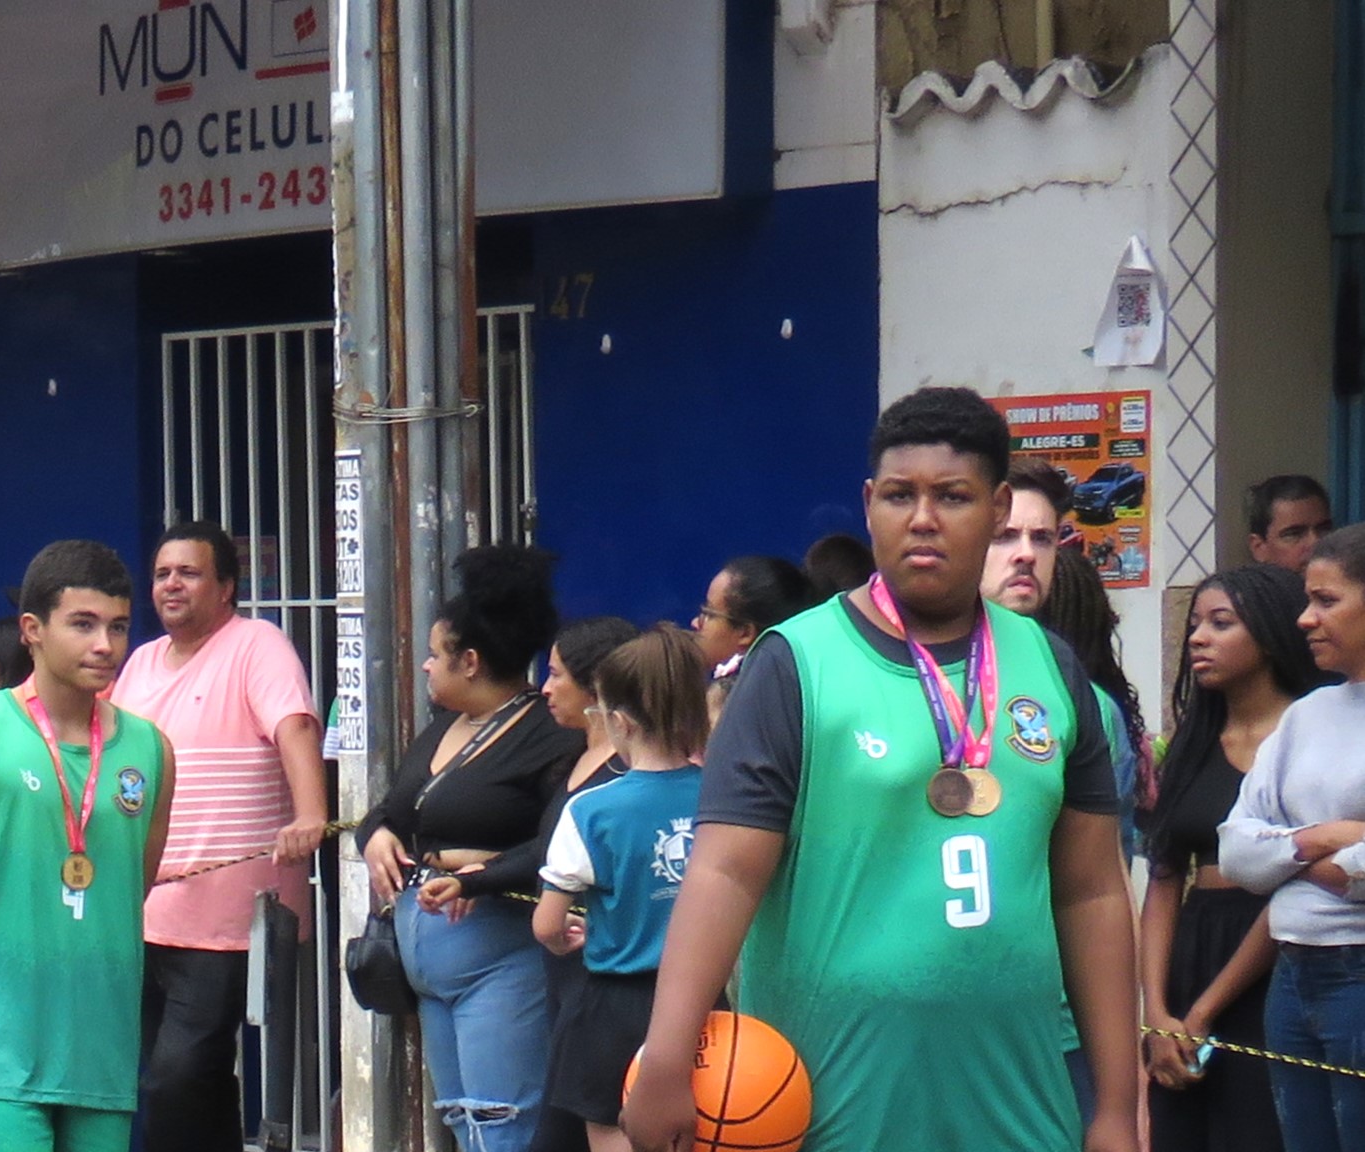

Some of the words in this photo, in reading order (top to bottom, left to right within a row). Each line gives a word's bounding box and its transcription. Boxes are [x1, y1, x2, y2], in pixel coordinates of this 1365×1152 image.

[136, 119, 183, 168] DO
[198, 100, 331, 158] CELUL
[1006, 407, 1038, 424] SHOW
[1038, 406, 1052, 423] DE
[1052, 402, 1100, 422] PRÊMIOS
[1020, 435, 1085, 449] ALEGRE-ES
[942, 834, 990, 928] 9
